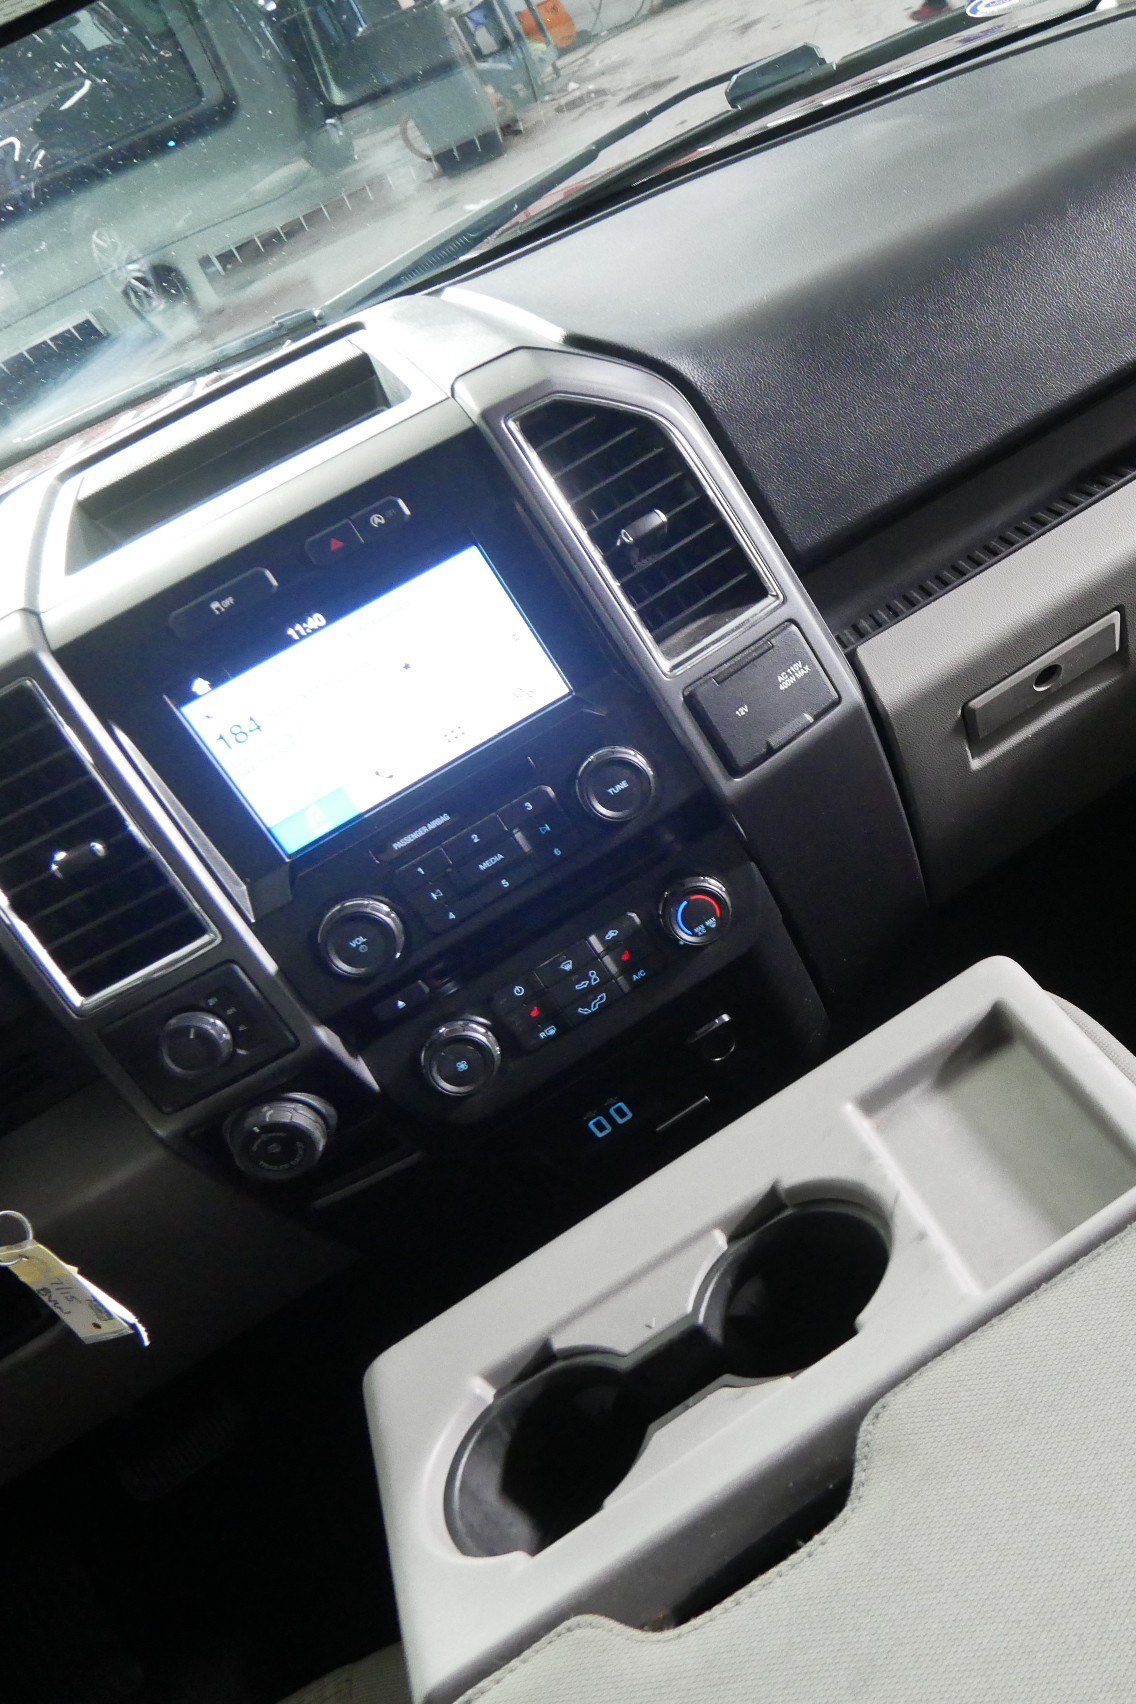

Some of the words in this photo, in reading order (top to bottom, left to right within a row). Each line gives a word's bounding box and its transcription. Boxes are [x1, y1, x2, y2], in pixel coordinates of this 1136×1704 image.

[286, 612, 327, 640] 11:40
[777, 671, 789, 683] AC
[787, 660, 803, 675] 110V
[779, 674, 797, 691] 400W
[795, 664, 812, 679] MAX
[735, 704, 749, 717] 12V
[216, 715, 263, 750] 184
[607, 779, 629, 796] TUNE
[524, 801, 533, 811] 3
[391, 825, 430, 850] PASSENGER
[426, 813, 451, 831] AIRBAG
[471, 833, 480, 843] 2
[553, 847, 562, 856] 6
[478, 853, 505, 871] MEDIA
[417, 866, 425, 875] 1
[501, 879, 510, 888] 5
[448, 911, 456, 920] 4
[349, 935, 368, 948] VOL
[632, 969, 646, 981] A/C
